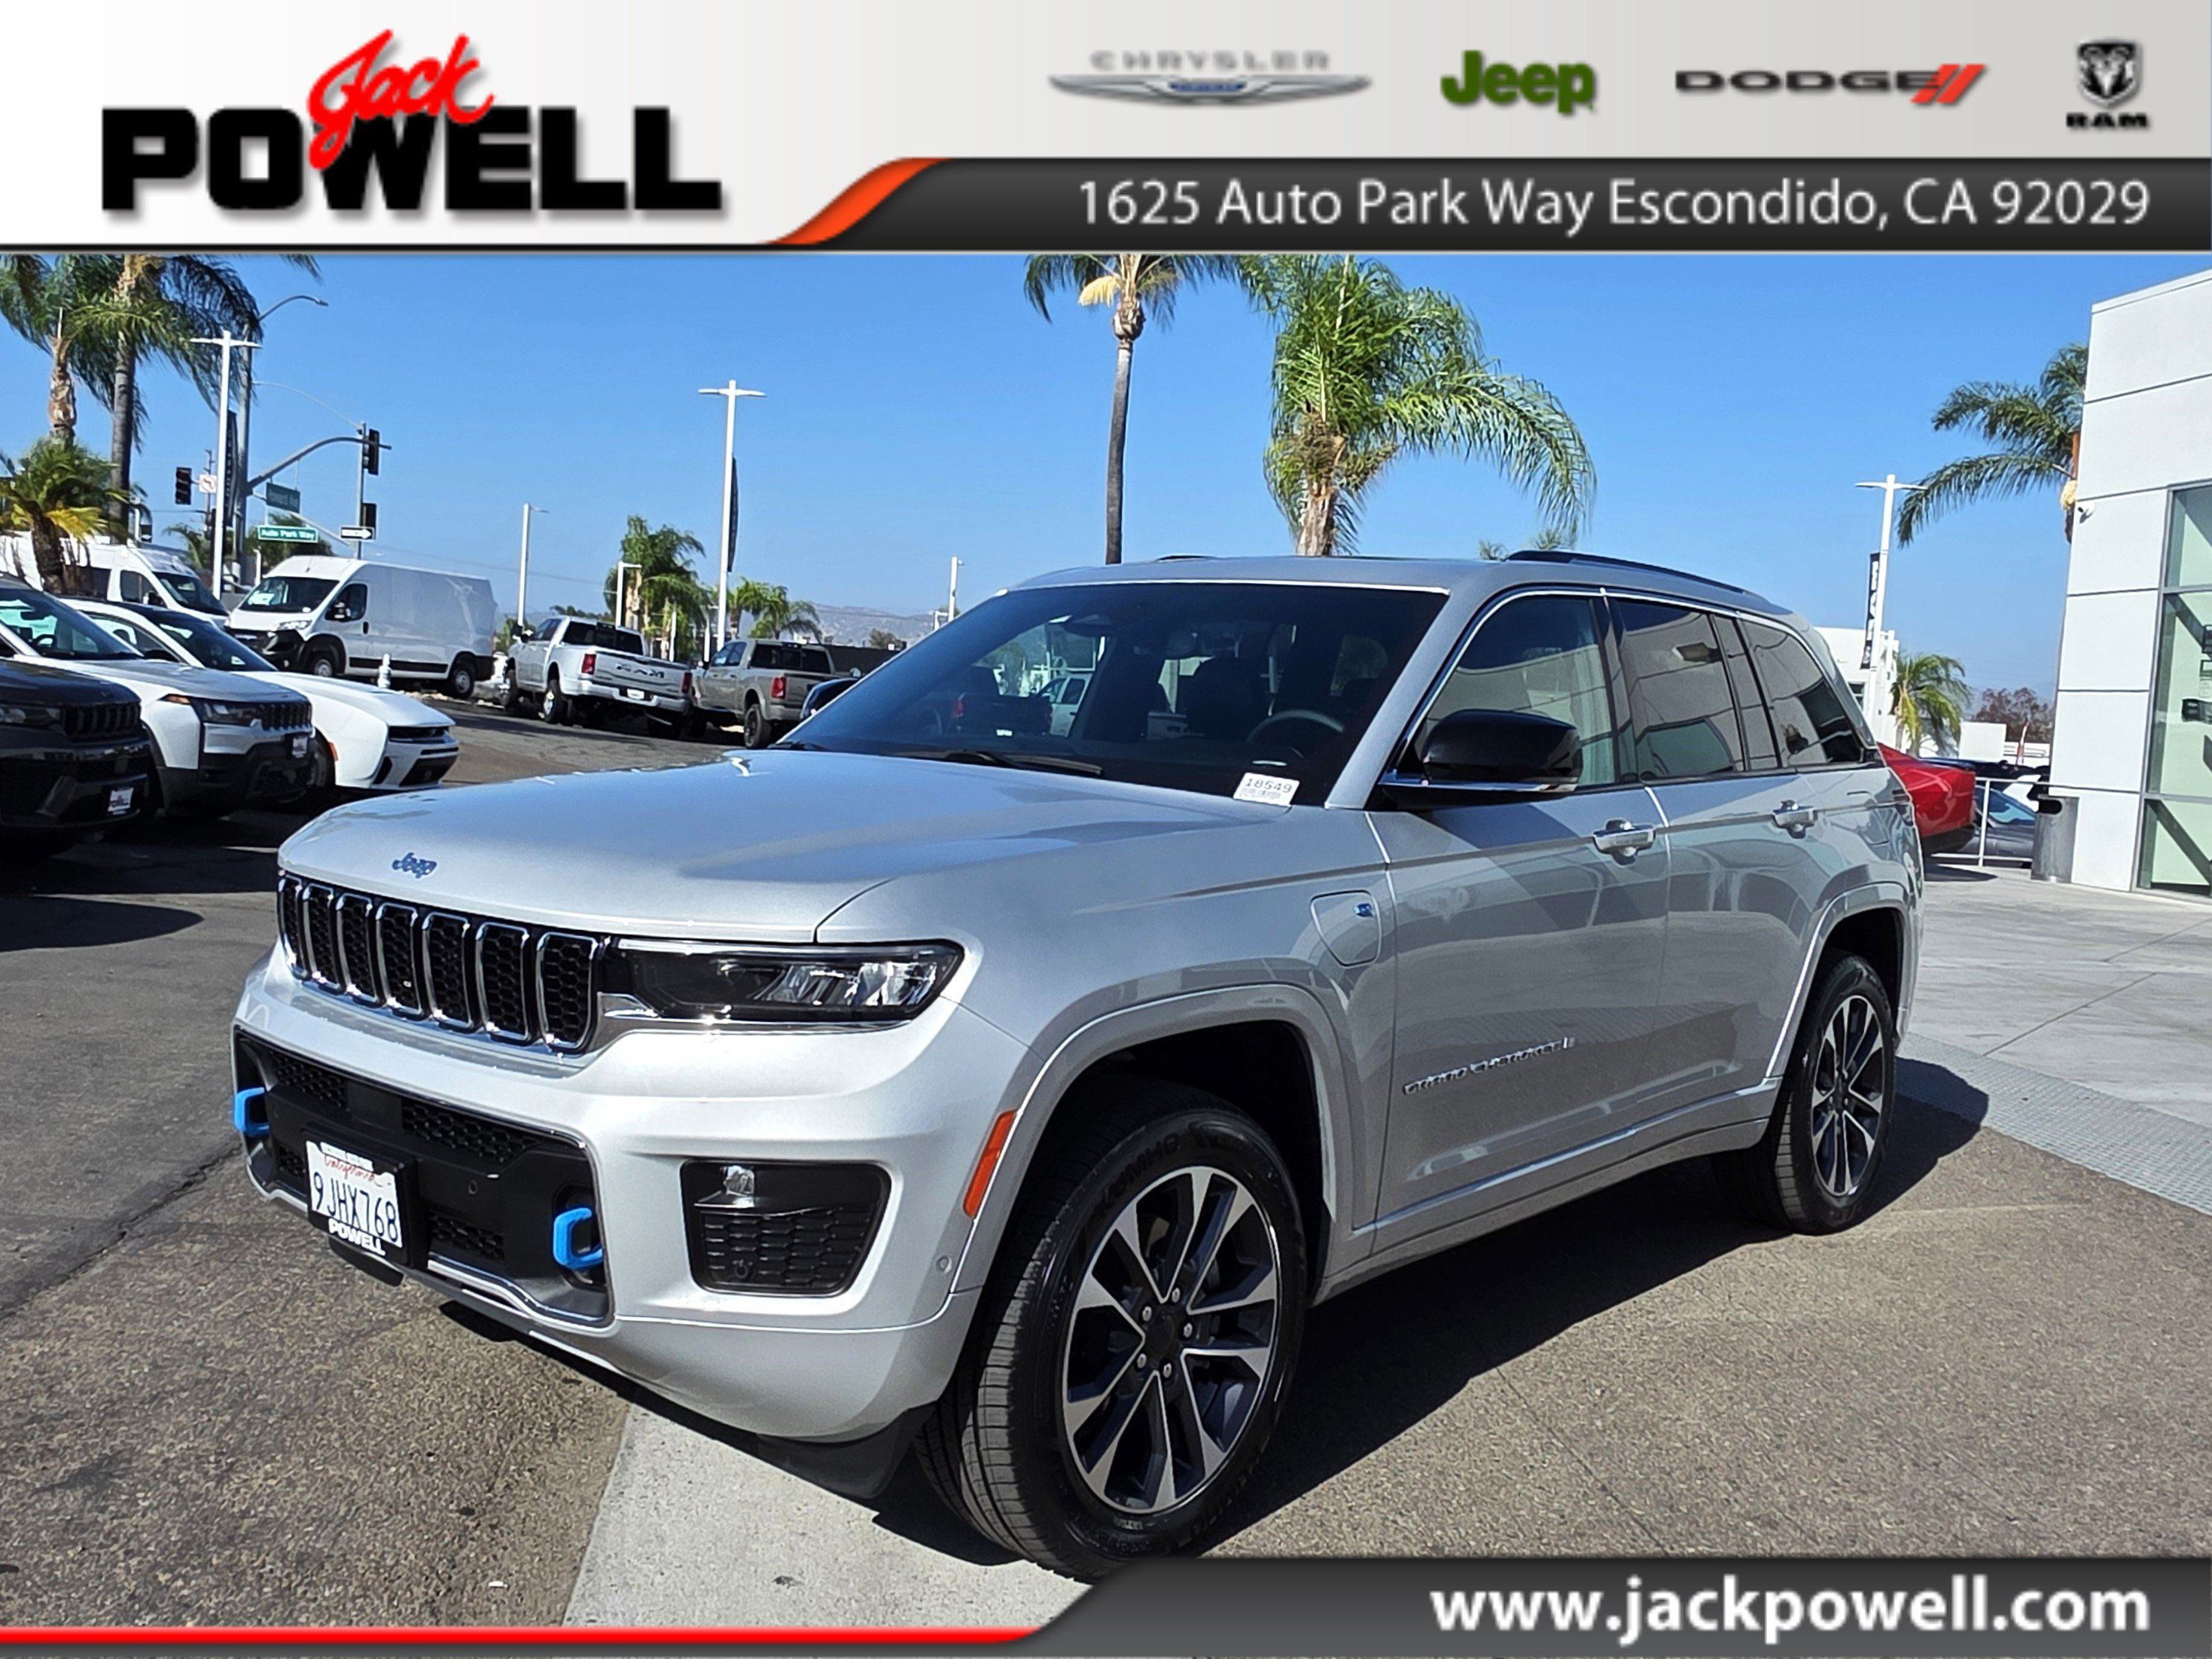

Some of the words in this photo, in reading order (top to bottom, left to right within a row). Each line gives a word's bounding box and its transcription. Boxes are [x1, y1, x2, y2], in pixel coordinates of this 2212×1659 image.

[261, 529, 279, 537] Auto
[280, 529, 297, 538] Park
[298, 531, 315, 541] Way
[1245, 778, 1293, 794] 18549
[392, 852, 437, 879] Jeep
[312, 1170, 399, 1243] 9JHX768
[328, 1217, 387, 1257] POWELL
